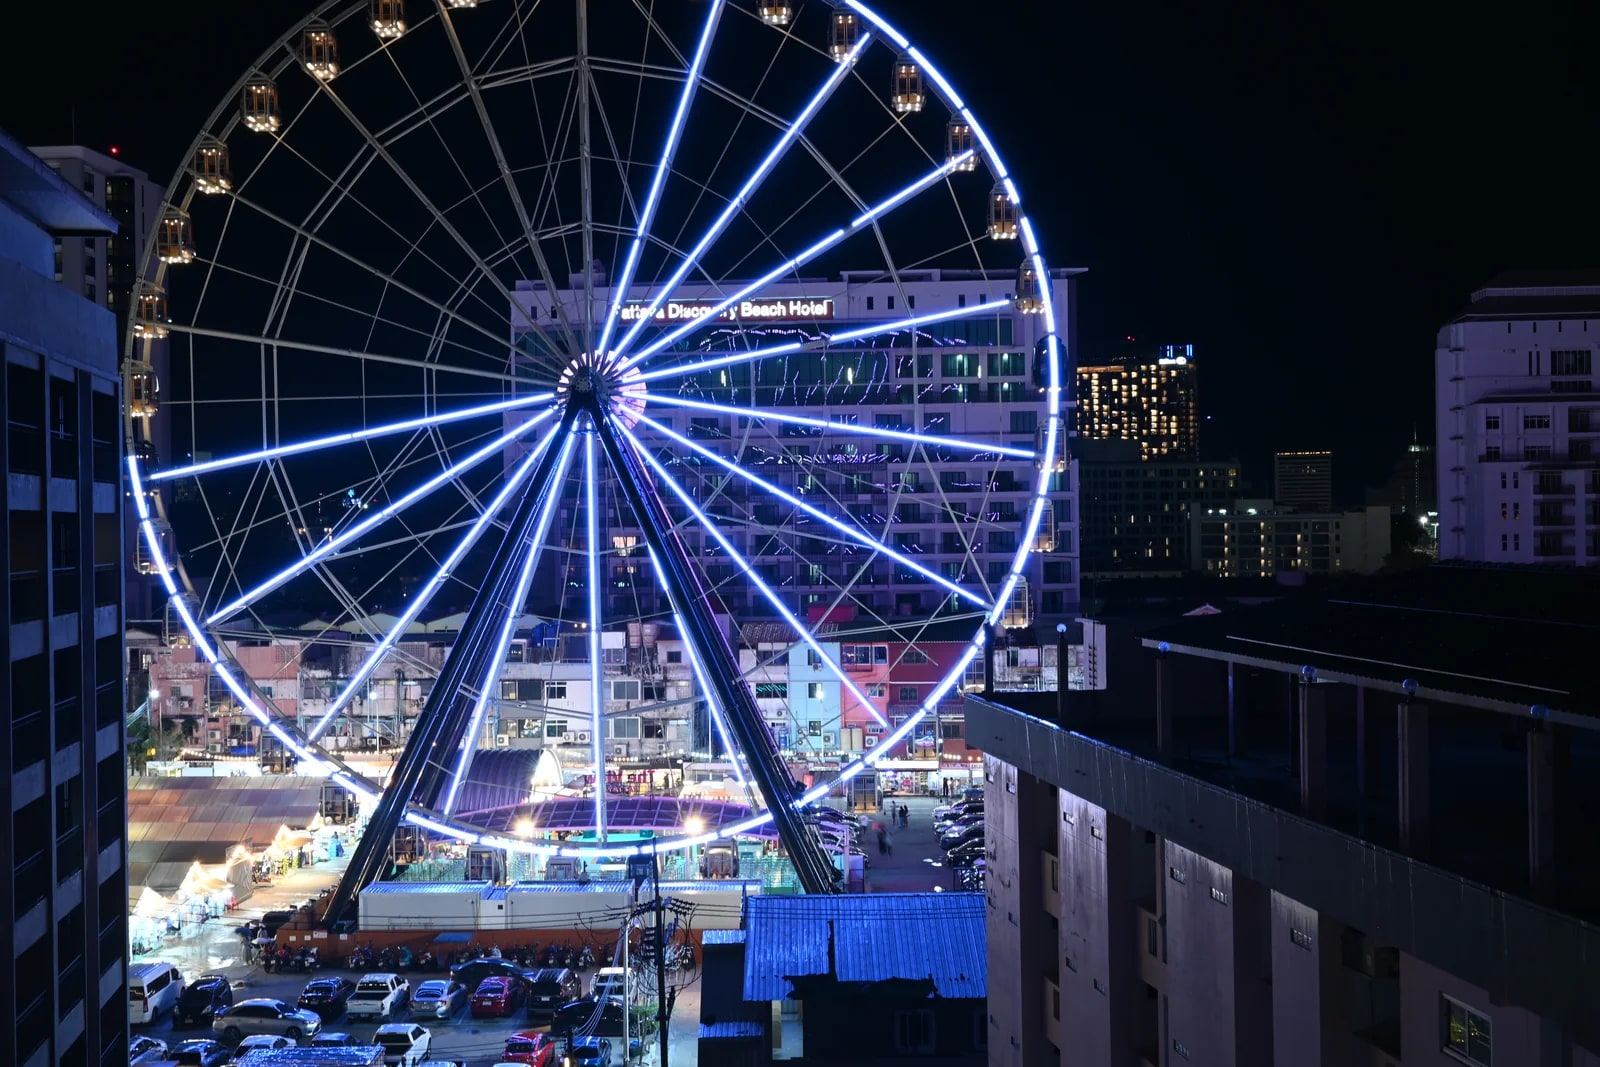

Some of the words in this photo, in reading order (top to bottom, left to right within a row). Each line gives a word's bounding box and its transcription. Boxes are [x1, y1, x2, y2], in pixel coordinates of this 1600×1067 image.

[611, 303, 665, 320] attaa
[668, 303, 738, 320] Discory
[741, 301, 787, 317] Beach
[789, 300, 828, 316] Hotel
